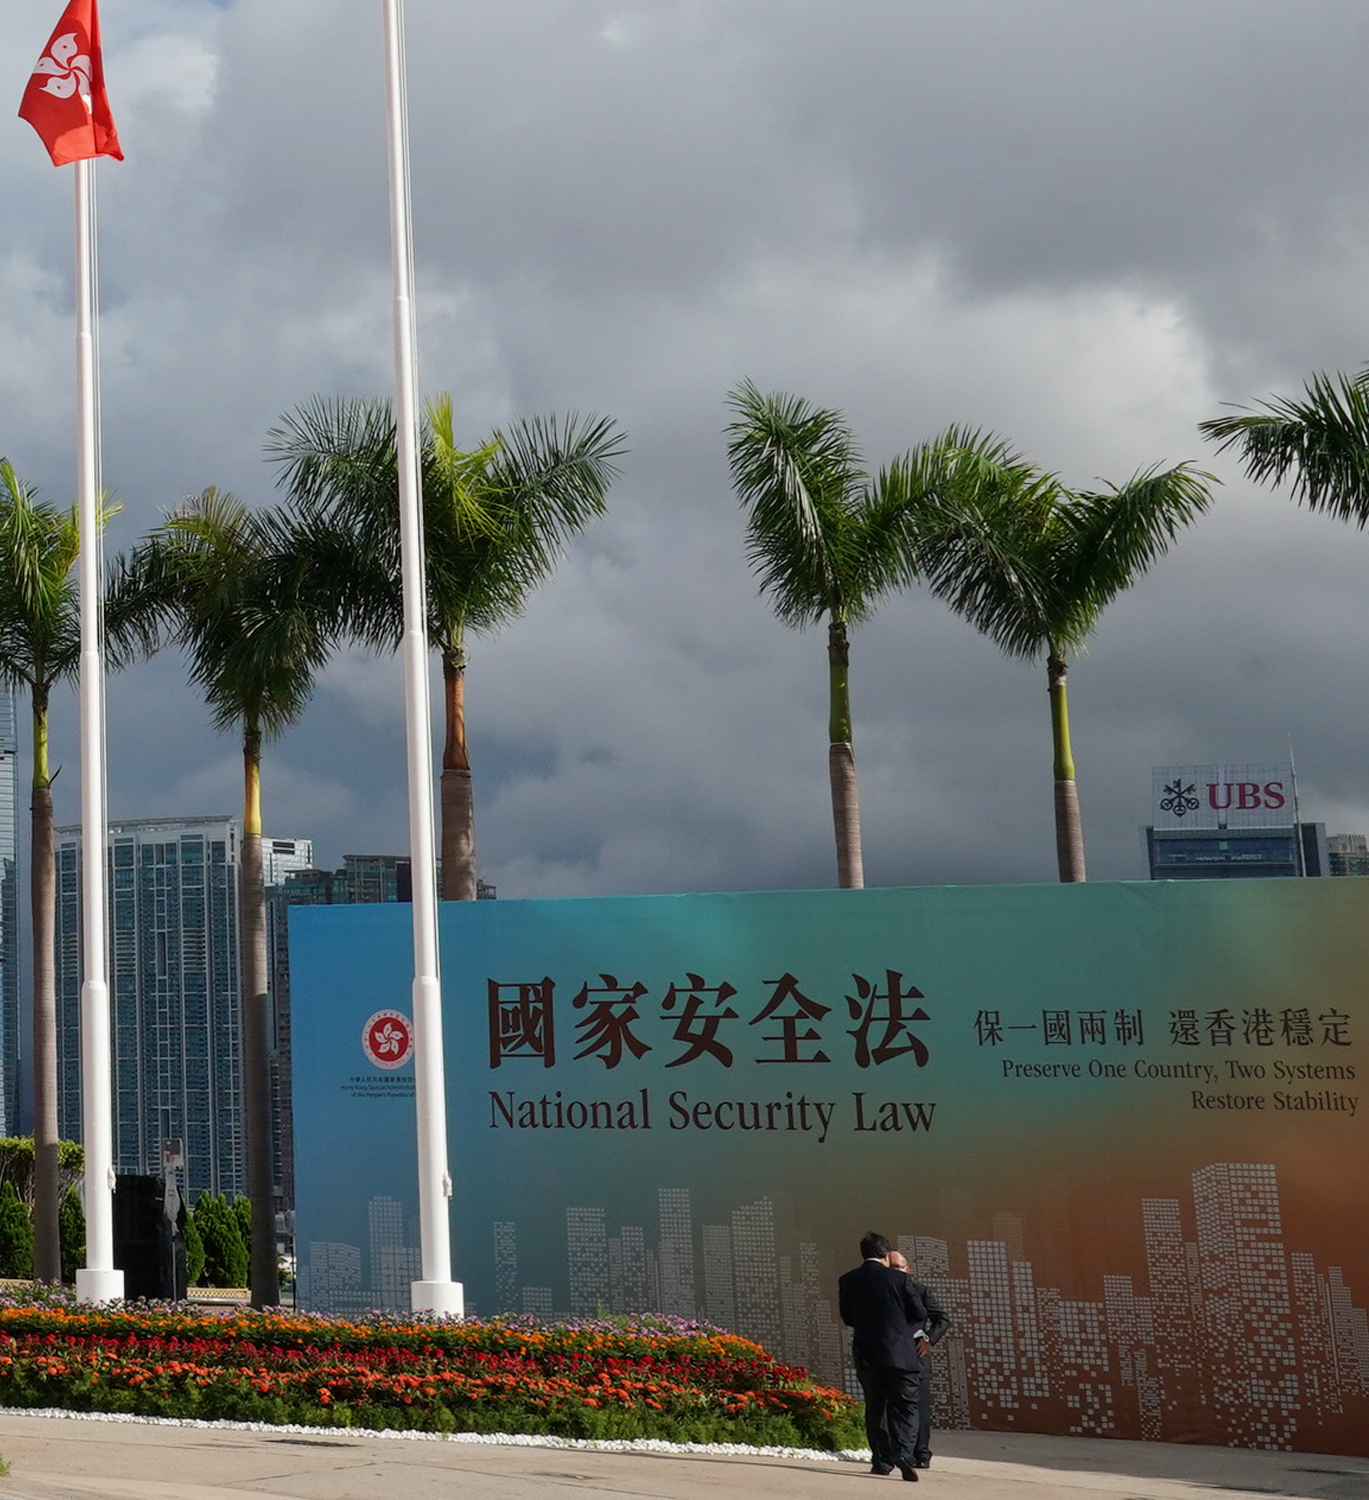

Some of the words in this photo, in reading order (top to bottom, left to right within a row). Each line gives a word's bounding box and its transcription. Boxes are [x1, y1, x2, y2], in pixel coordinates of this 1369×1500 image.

[1206, 782, 1286, 810] UBS
[487, 969, 931, 1069] 國家安全法
[973, 1008, 1144, 1047] 保一國兩制
[1168, 1007, 1353, 1047] 還香港穩定
[1001, 1059, 1081, 1078] Preserve
[1088, 1059, 1127, 1079] One
[1134, 1059, 1219, 1084] Country,
[1225, 1060, 1266, 1080] Two
[1273, 1060, 1356, 1084] Systems
[488, 1088, 652, 1131] National
[669, 1091, 836, 1143] Security
[852, 1092, 937, 1133] Law
[1191, 1090, 1266, 1110] Restore
[1273, 1090, 1359, 1117] Stability
